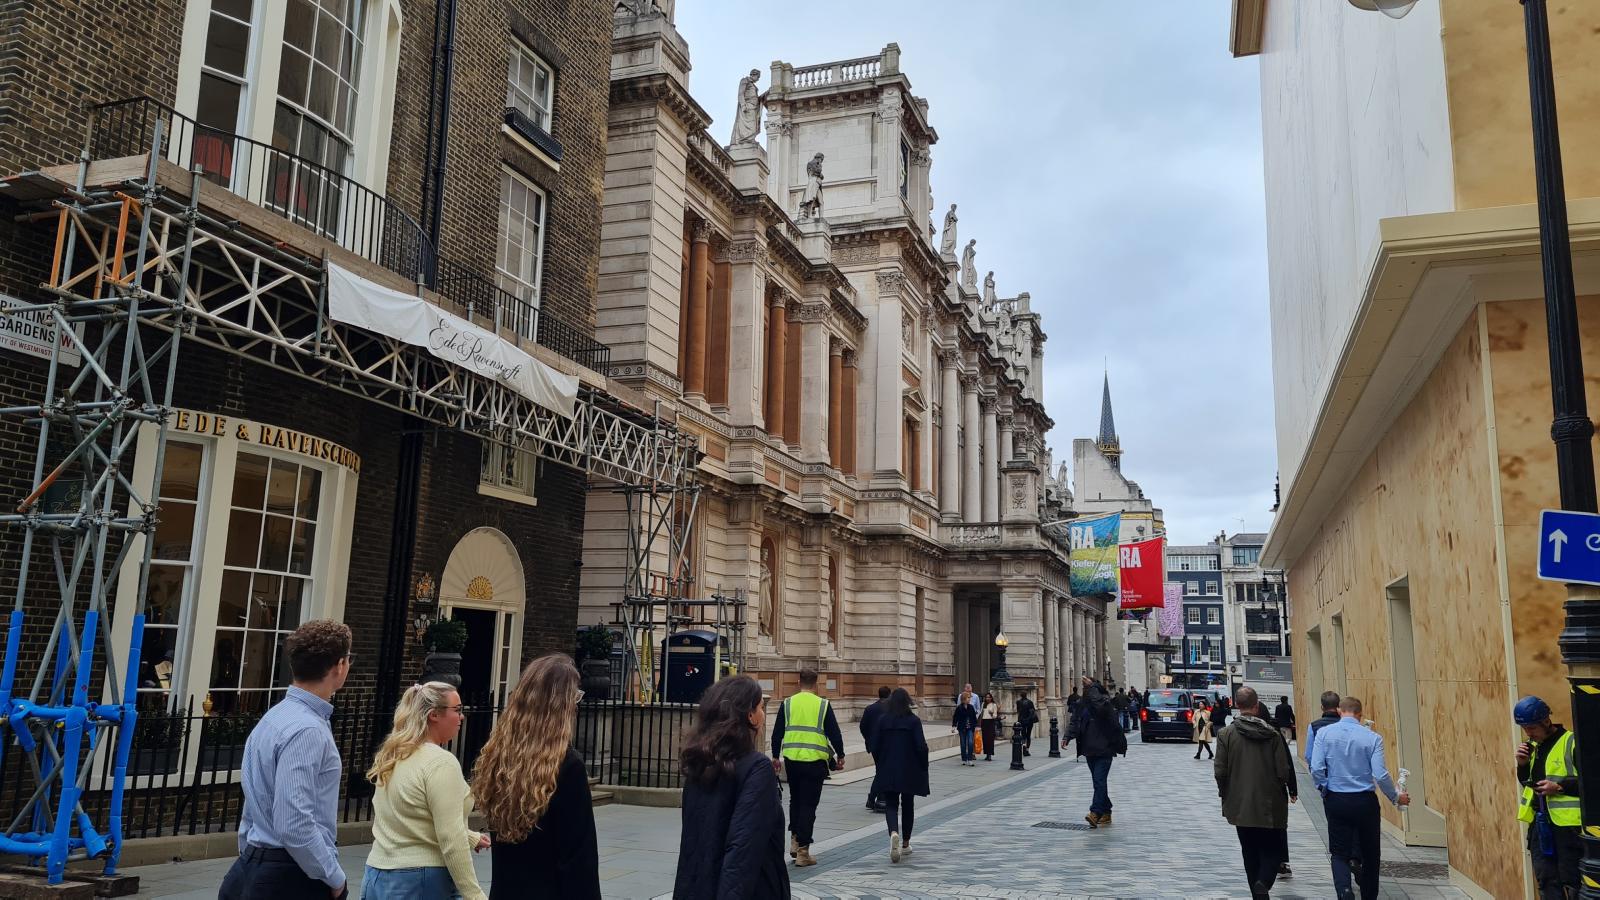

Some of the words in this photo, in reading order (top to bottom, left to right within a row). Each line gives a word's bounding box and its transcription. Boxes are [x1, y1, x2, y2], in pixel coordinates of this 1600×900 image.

[0, 316, 55, 343] GARDENS
[429, 315, 457, 350] Ede
[456, 340, 468, 356] &
[18, 343, 53, 357] WESTMINST
[175, 410, 227, 436] EDE
[236, 423, 250, 441] &
[1071, 526, 1095, 549] RA
[1120, 547, 1142, 568] RA
